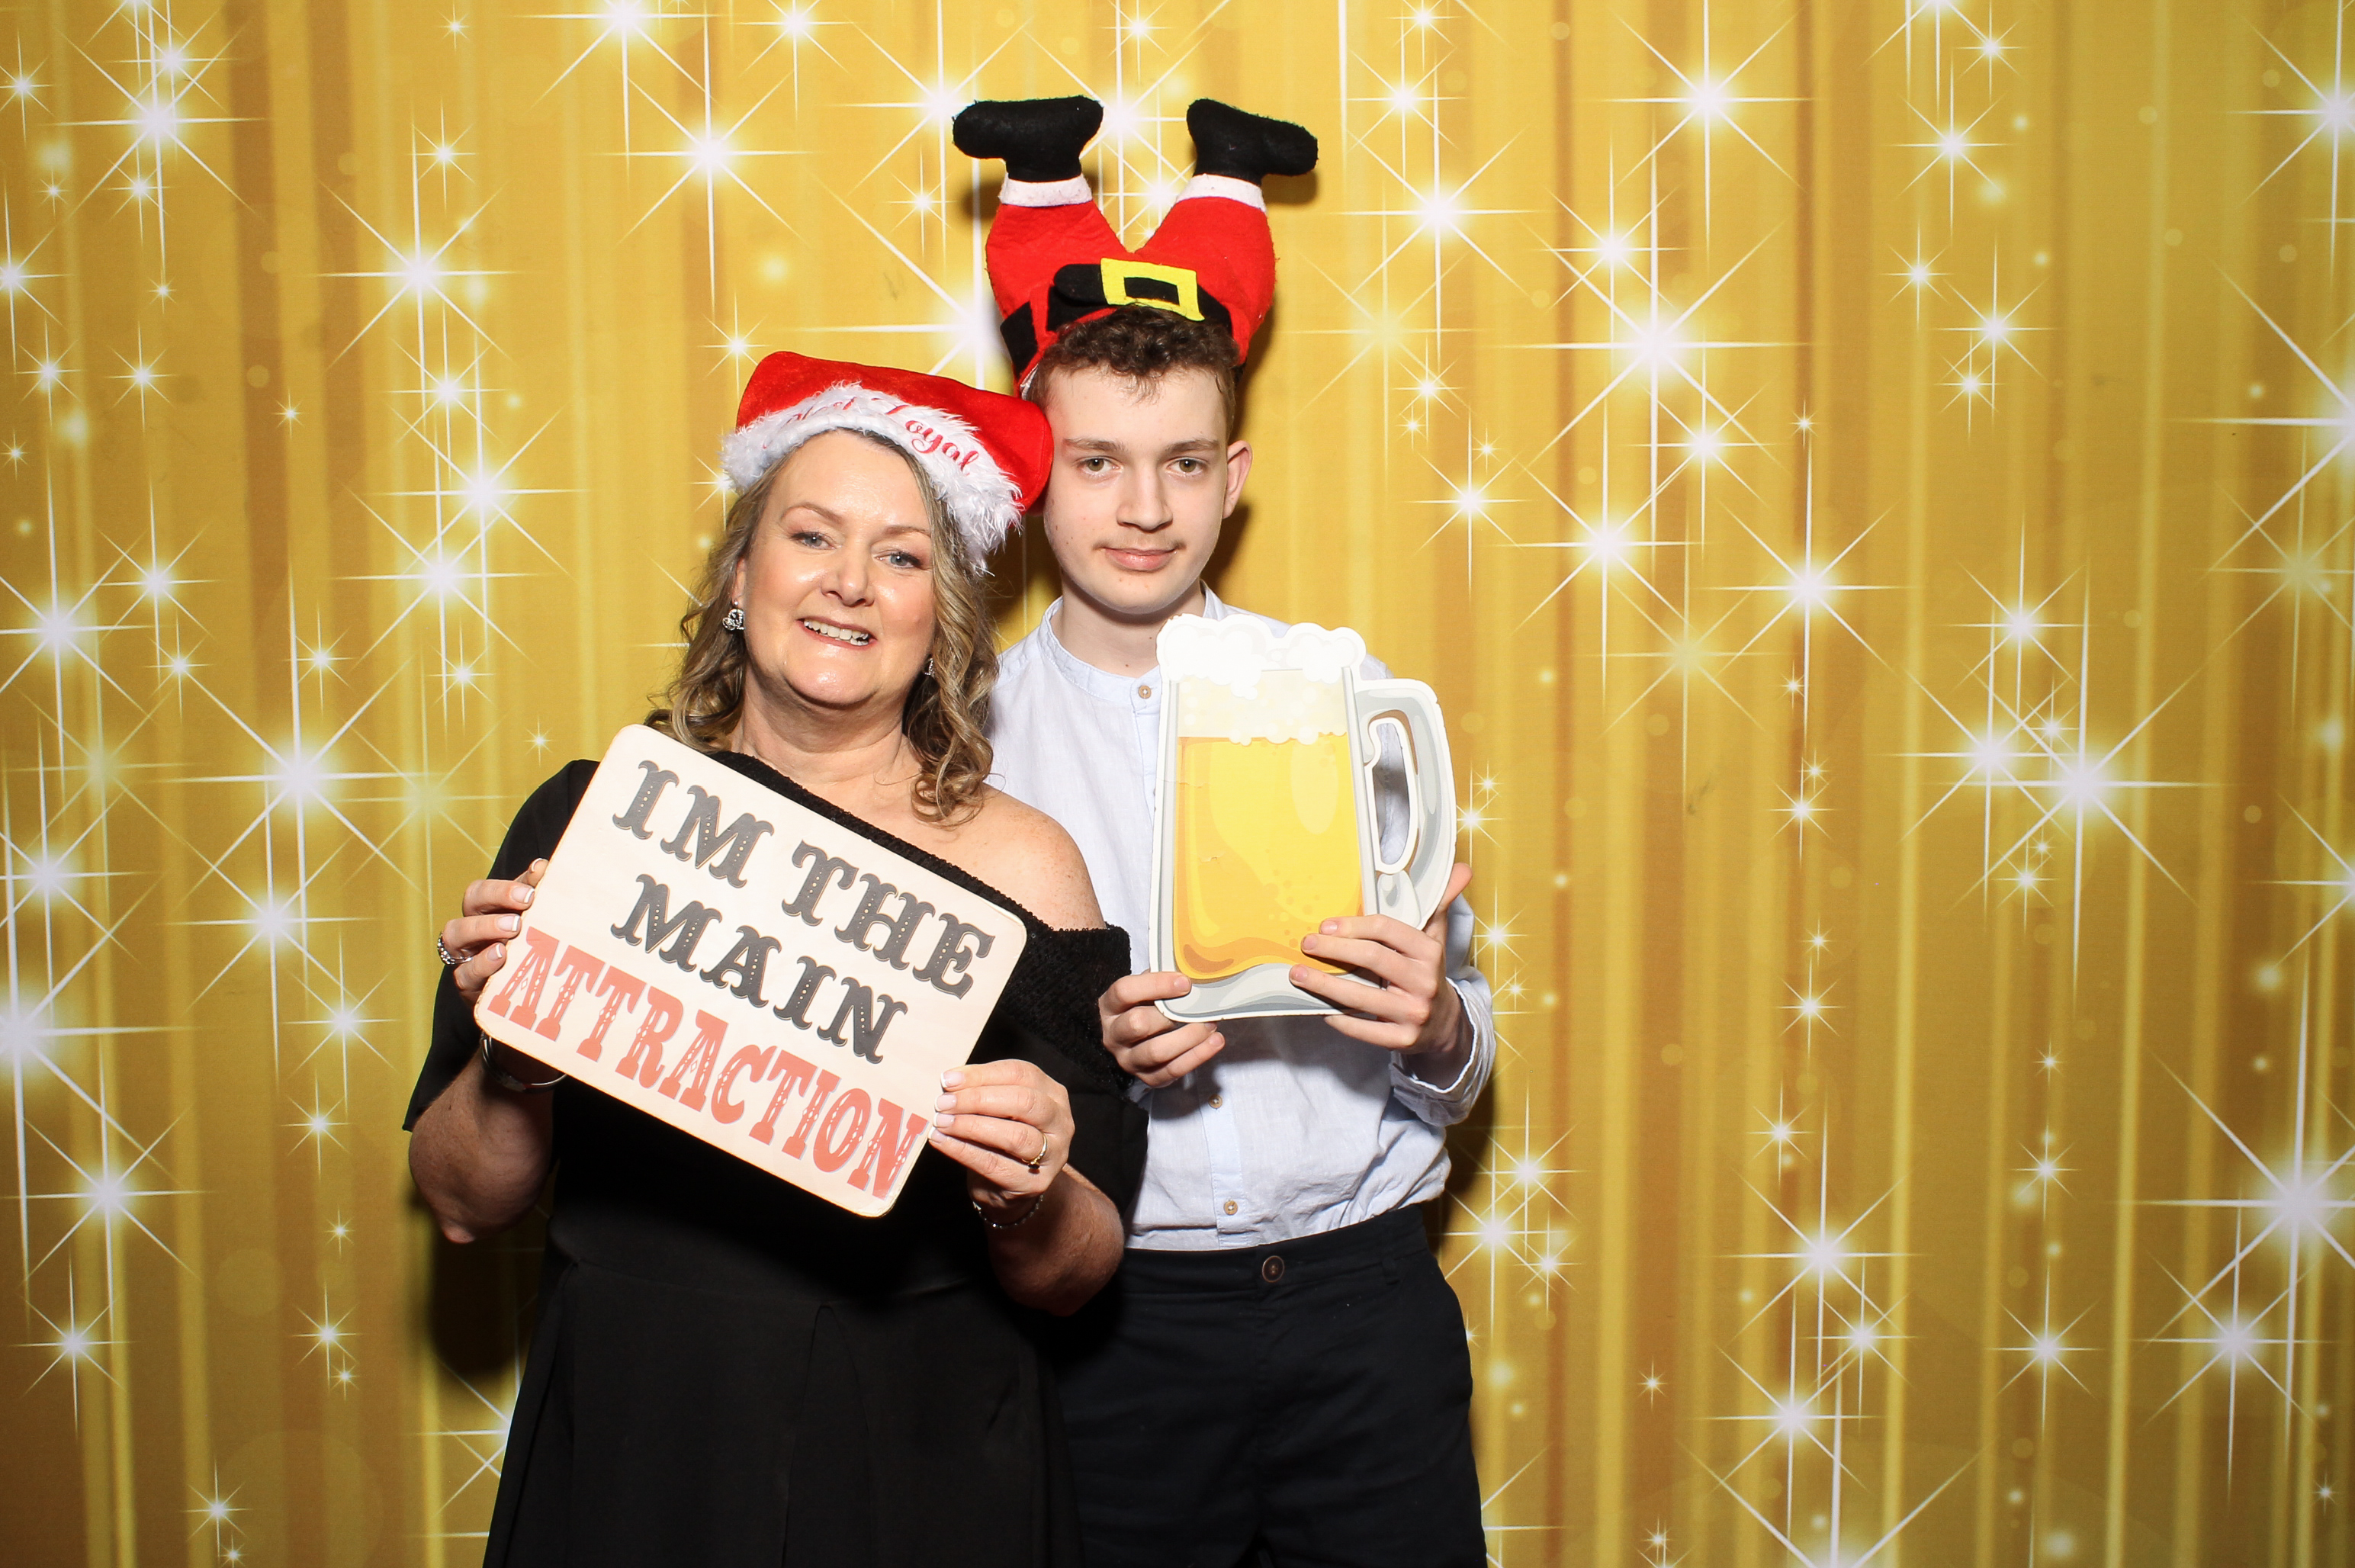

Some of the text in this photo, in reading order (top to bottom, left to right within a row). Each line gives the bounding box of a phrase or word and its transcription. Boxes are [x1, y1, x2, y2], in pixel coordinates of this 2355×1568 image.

[610, 873, 908, 1065] MAIN
[612, 760, 996, 1000] IM THE
[487, 926, 928, 1200] ATTRACTION
